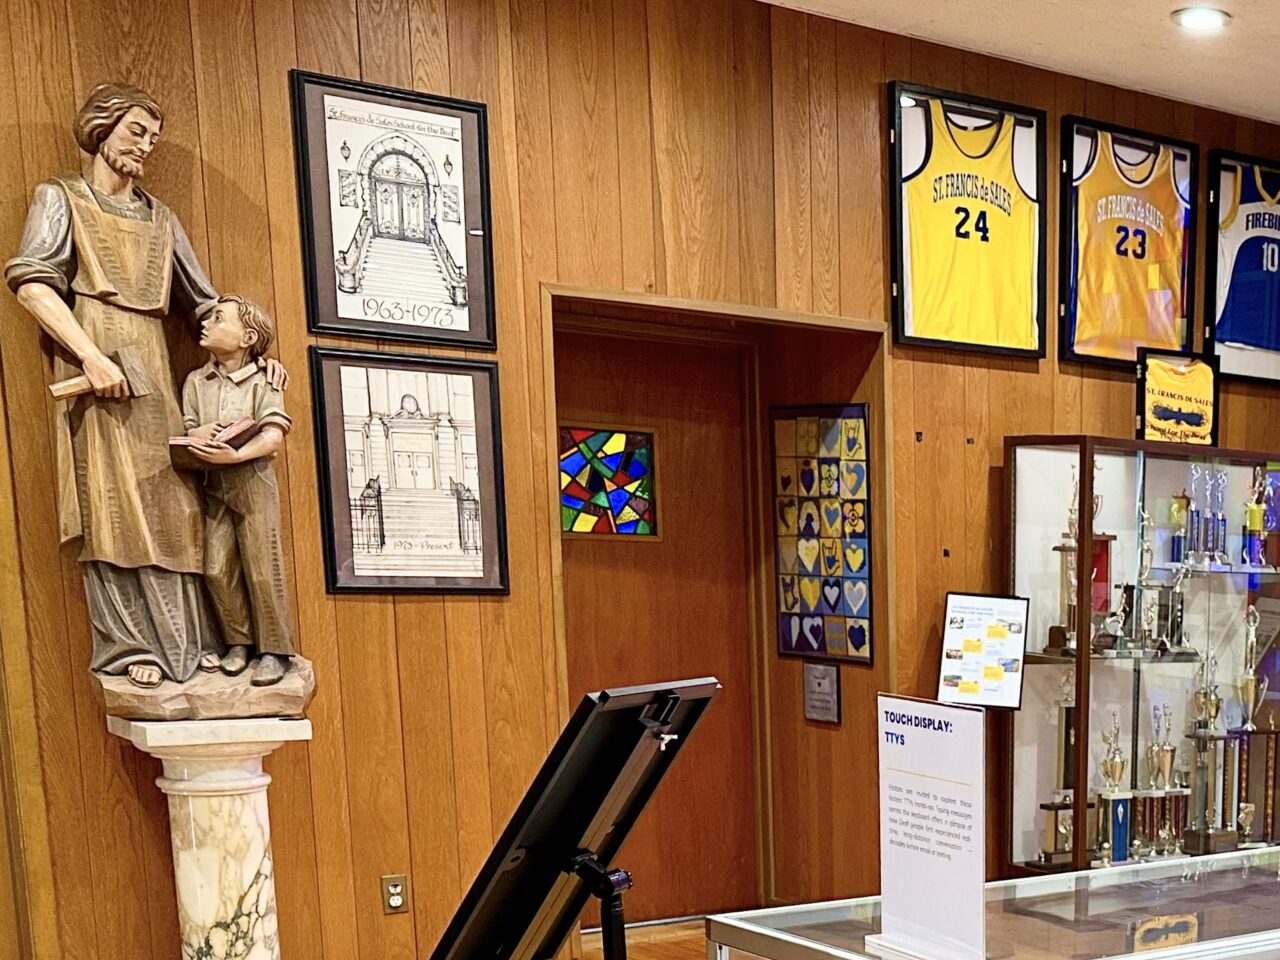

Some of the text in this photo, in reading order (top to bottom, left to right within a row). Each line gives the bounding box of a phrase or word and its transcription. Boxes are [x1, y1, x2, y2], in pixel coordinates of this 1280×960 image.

[933, 173, 1011, 217] ST. FRANCIS de SALES
[955, 206, 989, 242] 24
[1108, 194, 1136, 221] FRANCIS
[1137, 200, 1144, 224] de
[1145, 202, 1164, 238] SALES
[1116, 225, 1146, 260] 23
[1262, 242, 1279, 272] 10
[1158, 391, 1184, 401] FRANCIS
[1194, 398, 1213, 407] SALES
[421, 540, 454, 550] Present
[885, 711, 952, 733] TOUCH DISPLAY:
[885, 731, 904, 746] TTYS
